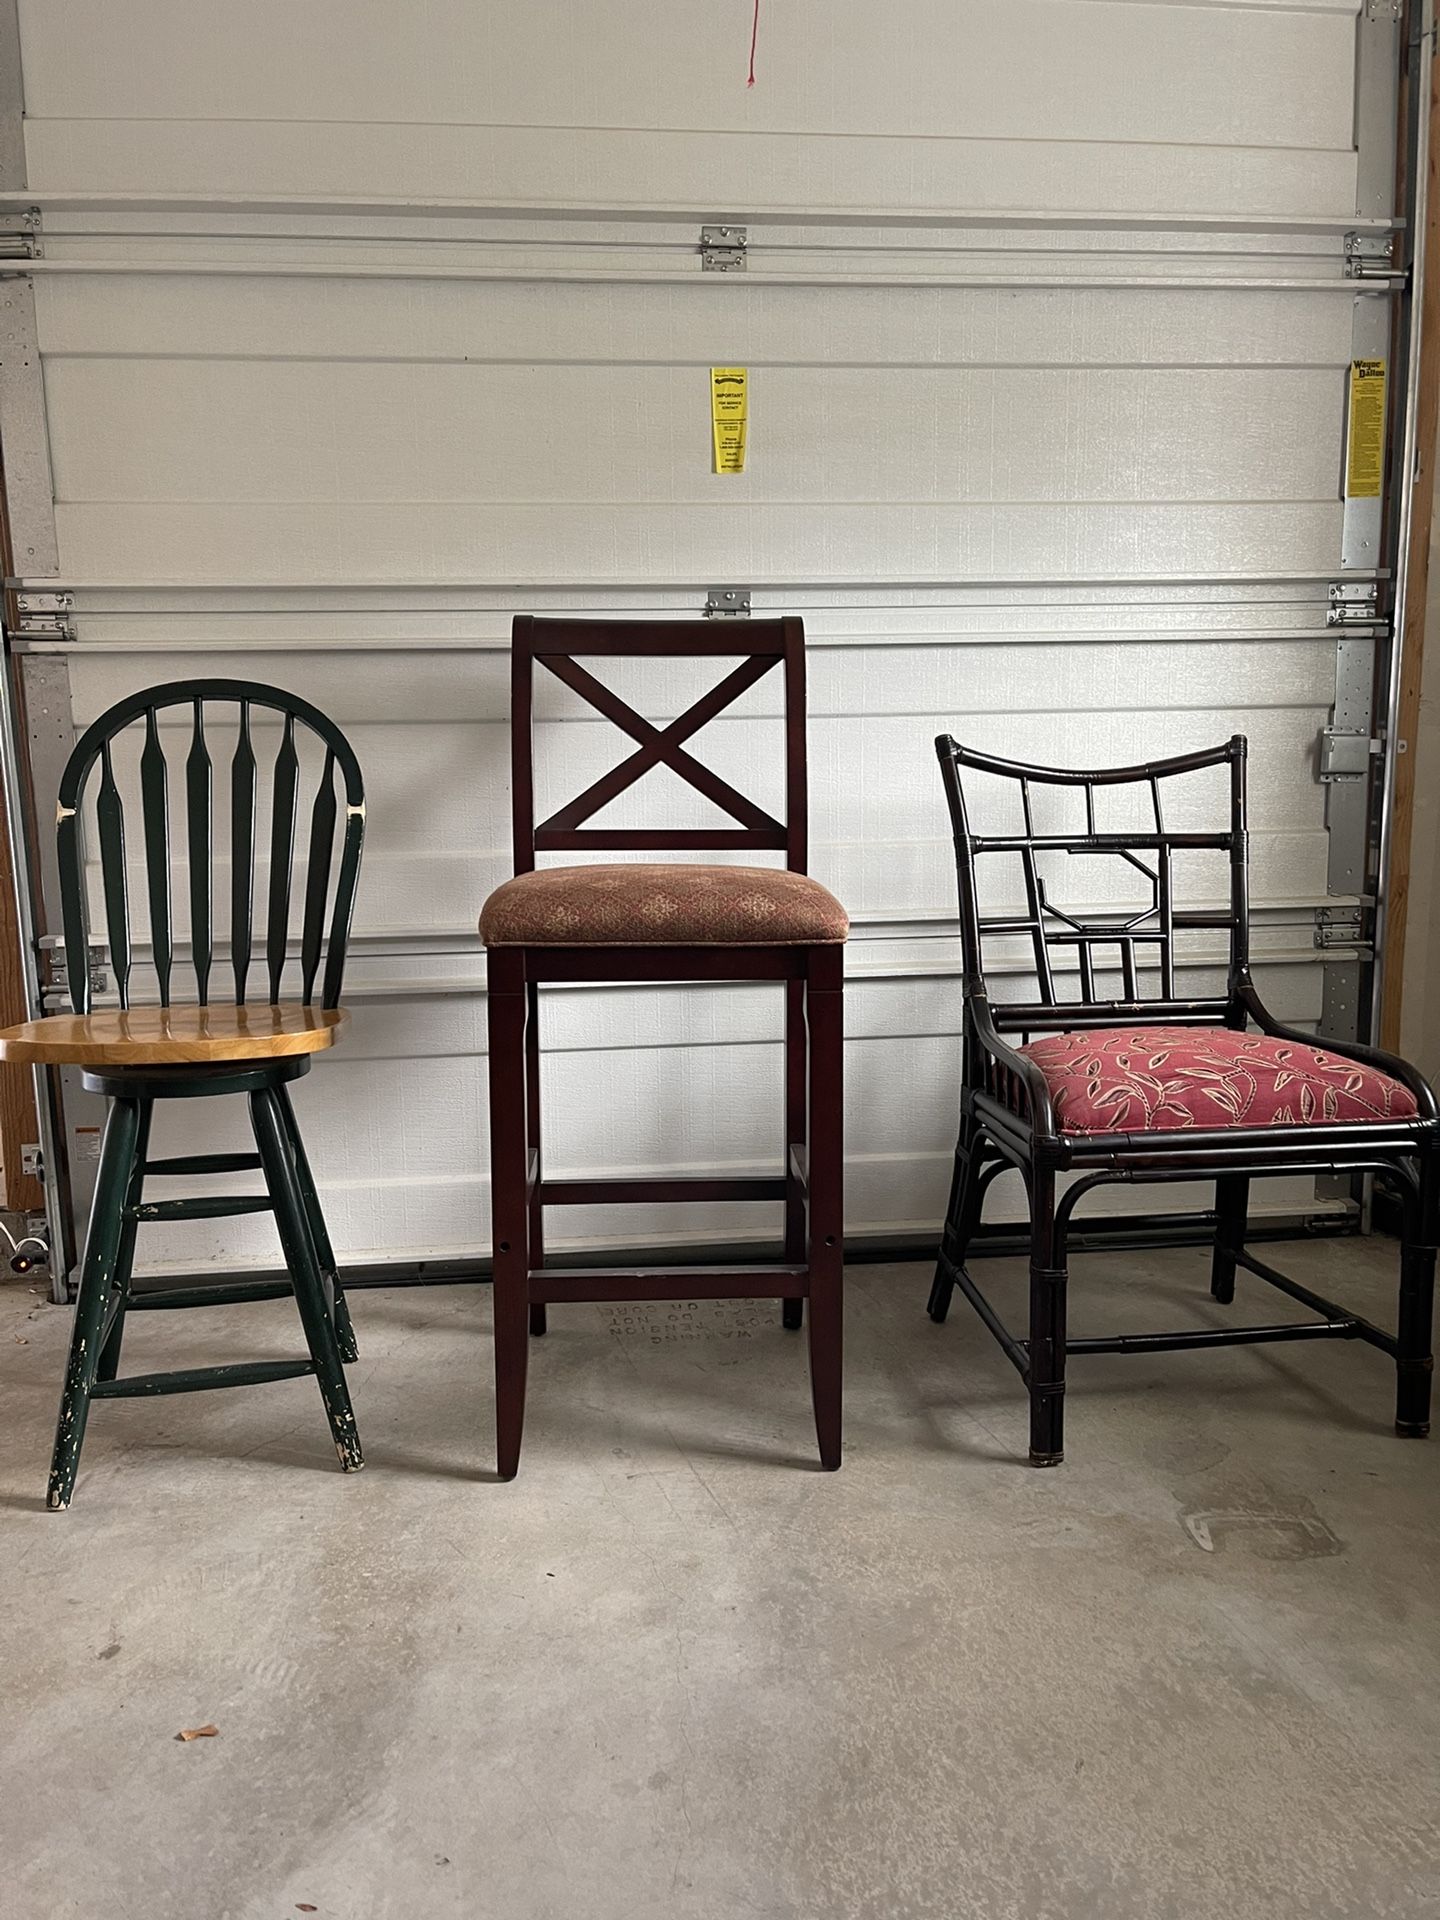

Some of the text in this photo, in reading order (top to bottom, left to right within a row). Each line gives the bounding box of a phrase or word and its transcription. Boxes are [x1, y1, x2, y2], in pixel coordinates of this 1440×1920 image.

[1353, 360, 1381, 371] Wayne
[1359, 369, 1385, 378] Dalton
[612, 1316, 649, 1326] NOT
